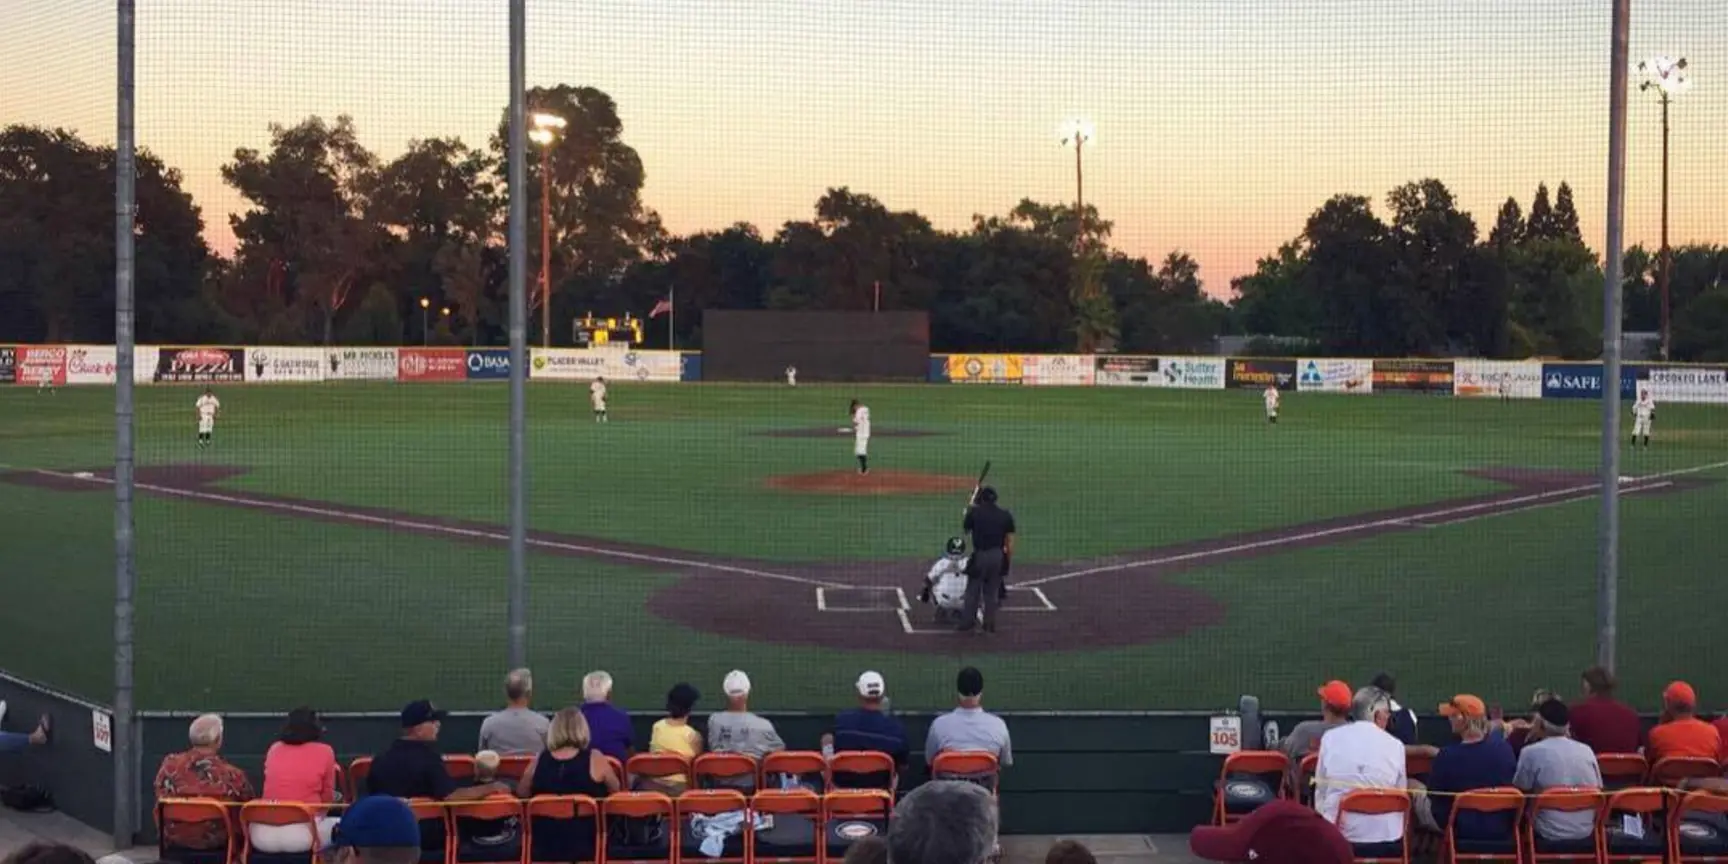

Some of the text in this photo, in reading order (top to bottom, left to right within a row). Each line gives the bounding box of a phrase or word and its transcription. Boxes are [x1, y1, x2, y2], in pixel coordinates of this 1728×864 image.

[170, 357, 234, 373] PIZZA
[484, 356, 510, 368] BASA
[1184, 362, 1216, 373] Sutter
[1184, 375, 1218, 386] Health
[1562, 375, 1601, 390] SAFE
[1653, 372, 1724, 384] CROOKED LANE
[1212, 732, 1238, 747] 105
